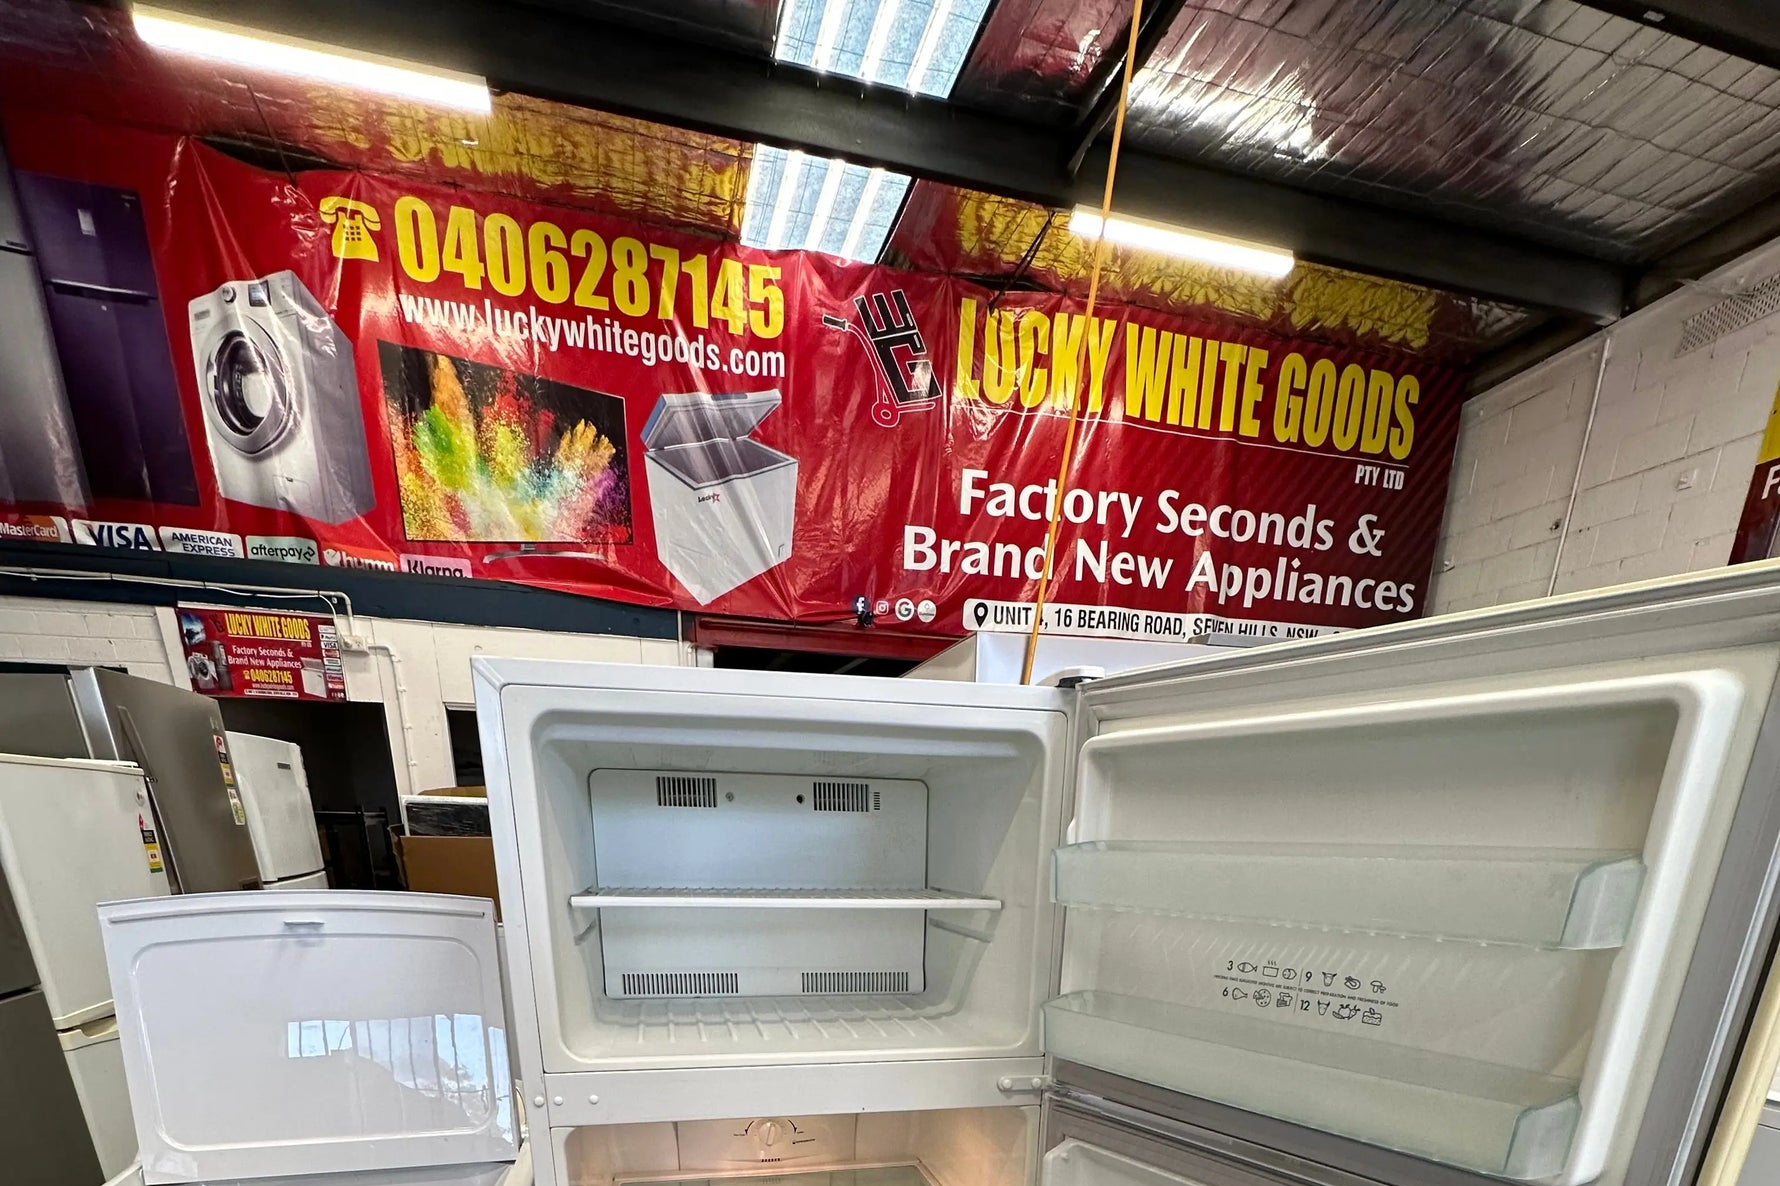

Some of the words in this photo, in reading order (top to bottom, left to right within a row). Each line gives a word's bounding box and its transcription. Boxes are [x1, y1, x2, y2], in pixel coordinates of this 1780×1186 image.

[394, 196, 784, 338] 0406287145
[399, 293, 785, 378] www.luckywhitegoods.com
[956, 297, 1115, 414] LUCKY
[1126, 321, 1269, 436] WHITE
[1273, 352, 1420, 460] GOODS
[1354, 464, 1380, 486] PTY
[1382, 468, 1405, 490] LTD
[959, 468, 1143, 538] Factory
[1156, 489, 1335, 551] Seconds
[1348, 513, 1386, 557] &
[83, 523, 153, 550] VISA
[171, 532, 232, 547] AMERICAN
[183, 543, 236, 557] EXPRESS
[251, 545, 302, 559] afterpay
[903, 525, 1054, 581] Brand
[1075, 538, 1174, 589] New
[1185, 551, 1415, 613] Appliances
[225, 613, 253, 635] LUCKY
[252, 615, 282, 638] WHITE
[281, 617, 311, 640] GOODS
[994, 606, 1032, 625] UNIT
[1055, 608, 1072, 627] 16
[1078, 610, 1139, 635] BEARING
[1144, 614, 1186, 639] ROAD,
[232, 645, 257, 657] Factory
[258, 647, 286, 657] Seconds
[227, 655, 249, 665] Brand
[250, 657, 265, 666] New
[267, 658, 302, 668] Appliances
[1226, 960, 1234, 971] 3
[1305, 971, 1312, 982] 9
[1222, 987, 1229, 997] 6
[1300, 1000, 1310, 1011] 12
